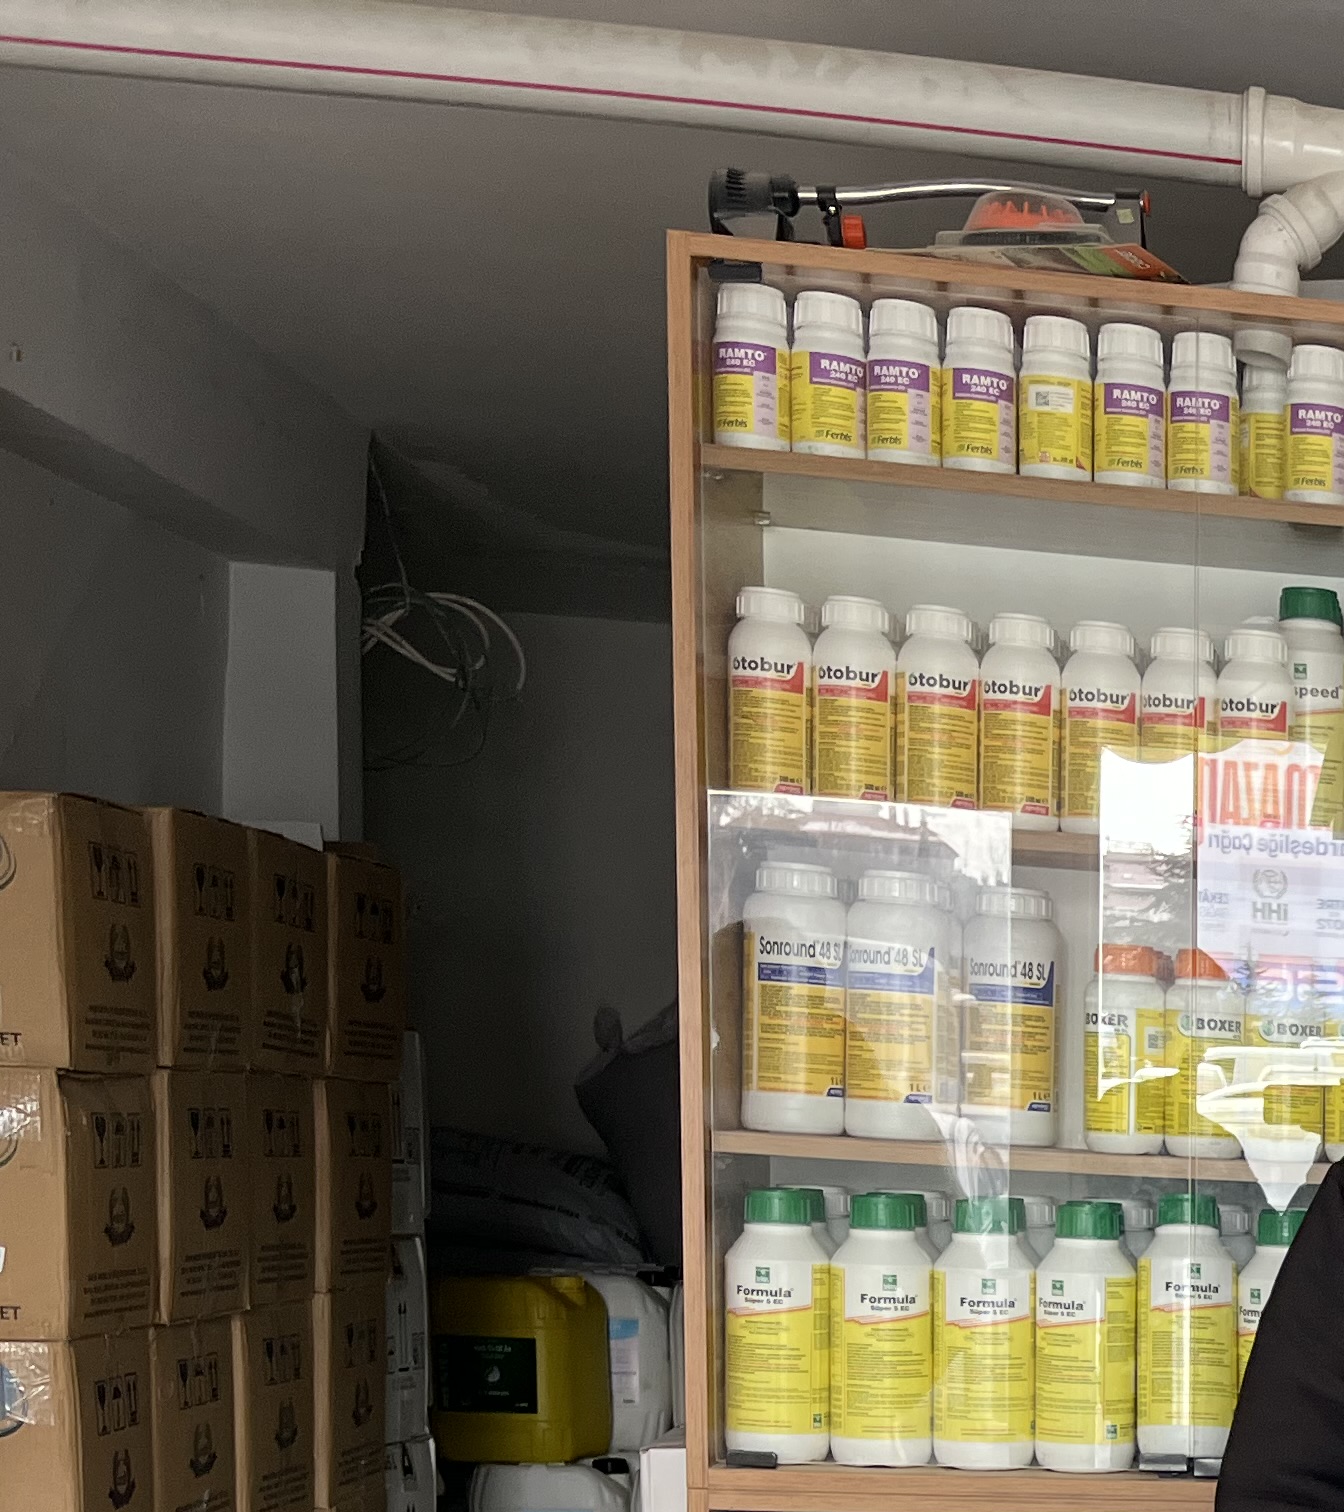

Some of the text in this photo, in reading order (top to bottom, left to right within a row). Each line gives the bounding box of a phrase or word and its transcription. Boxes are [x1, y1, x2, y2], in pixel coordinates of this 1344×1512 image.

[820, 358, 863, 378] RAMTO
[874, 364, 917, 379] RAMTO
[961, 373, 1007, 391] RAMTO
[1176, 396, 1219, 410] RAMTO
[1020, 960, 1034, 980] 48
[1036, 963, 1046, 981] SL
[1196, 1017, 1241, 1034] BOXER
[737, 1284, 793, 1299] Formula
[1165, 1281, 1219, 1295] Formula
[960, 1297, 1015, 1310] Formula
